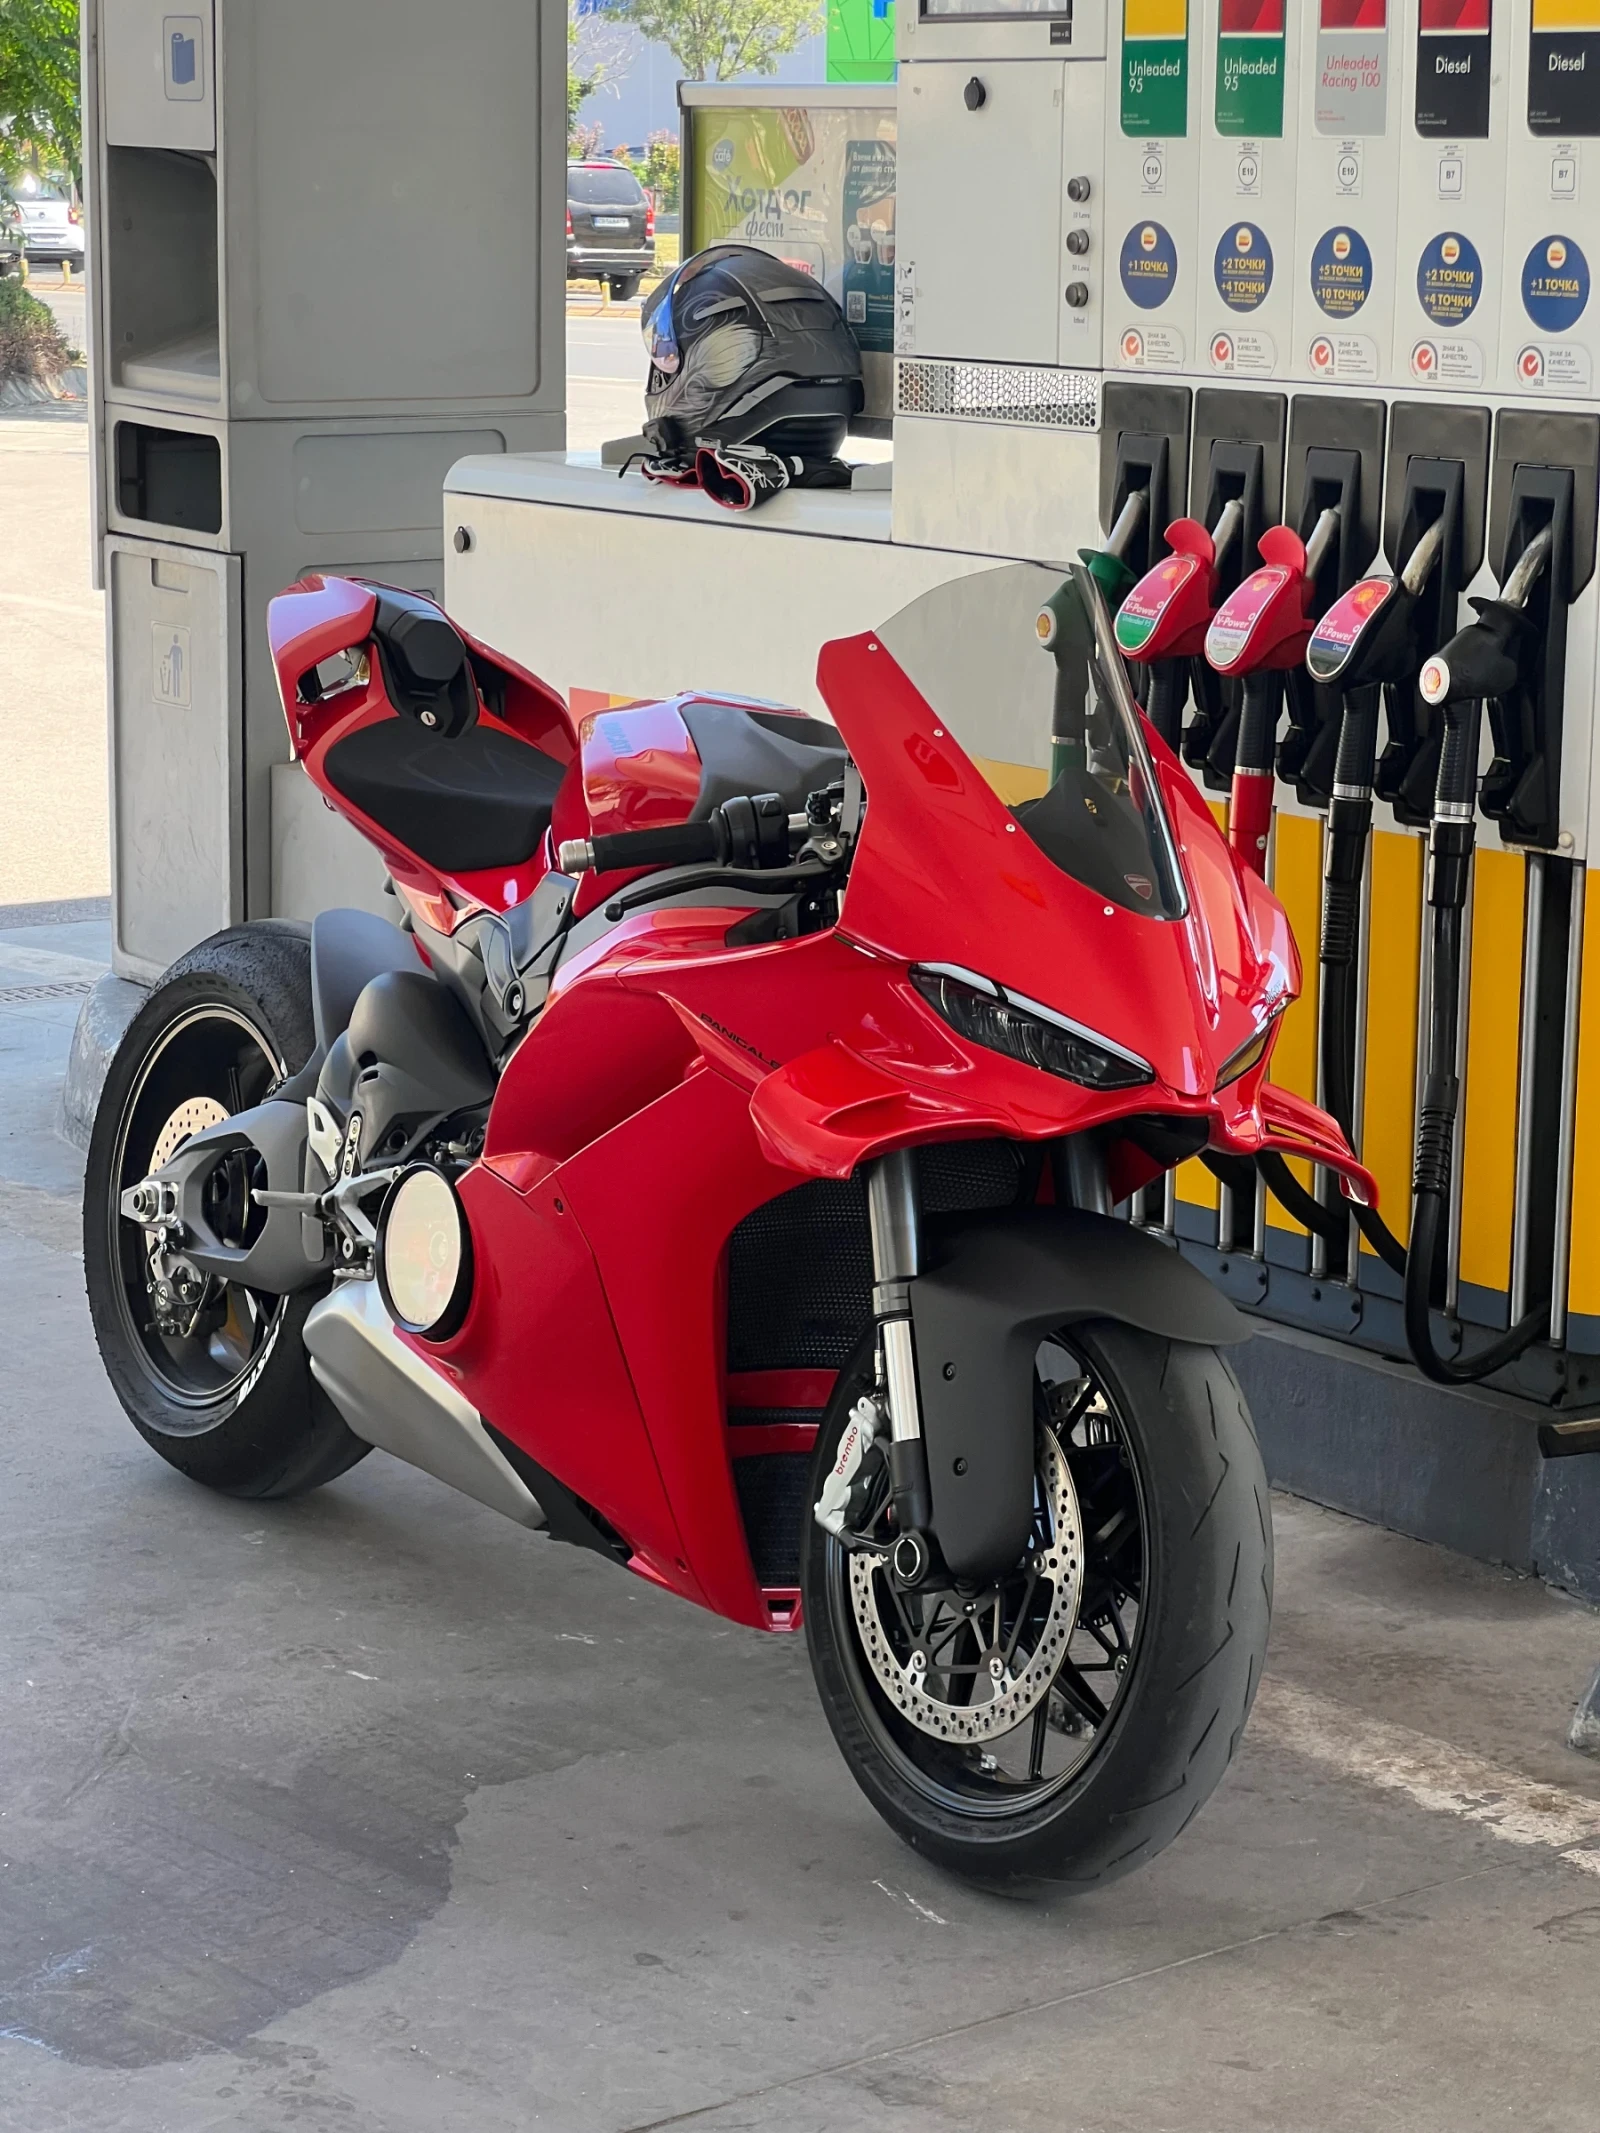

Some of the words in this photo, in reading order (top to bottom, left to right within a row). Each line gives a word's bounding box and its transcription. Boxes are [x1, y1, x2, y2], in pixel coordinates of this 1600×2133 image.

[1129, 58, 1181, 77] Unleaded
[1224, 57, 1277, 76] Unleaded
[1327, 54, 1378, 70] Unleaded
[1435, 55, 1471, 74] Diesel
[1548, 52, 1586, 72] Diesel
[1129, 78, 1143, 93] 95
[1224, 76, 1239, 91] 95
[1322, 72, 1358, 92] Racing
[1361, 73, 1381, 88] 100
[1146, 166, 1159, 175] E10
[1242, 167, 1254, 176] E10
[1341, 167, 1355, 176] E10
[1446, 170, 1455, 179] B7
[1558, 169, 1568, 178] B7
[724, 176, 812, 220] Хотдог
[745, 213, 785, 245] фест
[1128, 260, 1138, 271] +1
[1140, 260, 1168, 273] ТОЧКА
[1222, 257, 1233, 270] +2
[1235, 258, 1266, 271] ТОЧКИ
[1319, 264, 1330, 276] +5
[1331, 264, 1363, 277] ТОЧКИ
[1425, 268, 1437, 281] +2
[1439, 269, 1474, 284] ТОЧКИ
[1221, 281, 1232, 293] +4
[1233, 281, 1265, 294] ТОЧКИ
[1531, 278, 1543, 290] +1
[1545, 278, 1579, 292] ТОЧКА
[1316, 287, 1332, 300] +10
[1333, 288, 1365, 301] ТОЧКИ
[1424, 293, 1436, 305] +4
[1437, 294, 1472, 308] ТОЧКИ
[1125, 601, 1158, 617] V-Power
[1216, 616, 1250, 629] V-Power
[1318, 624, 1353, 641] V-Power
[835, 1426, 858, 1475] brembo
